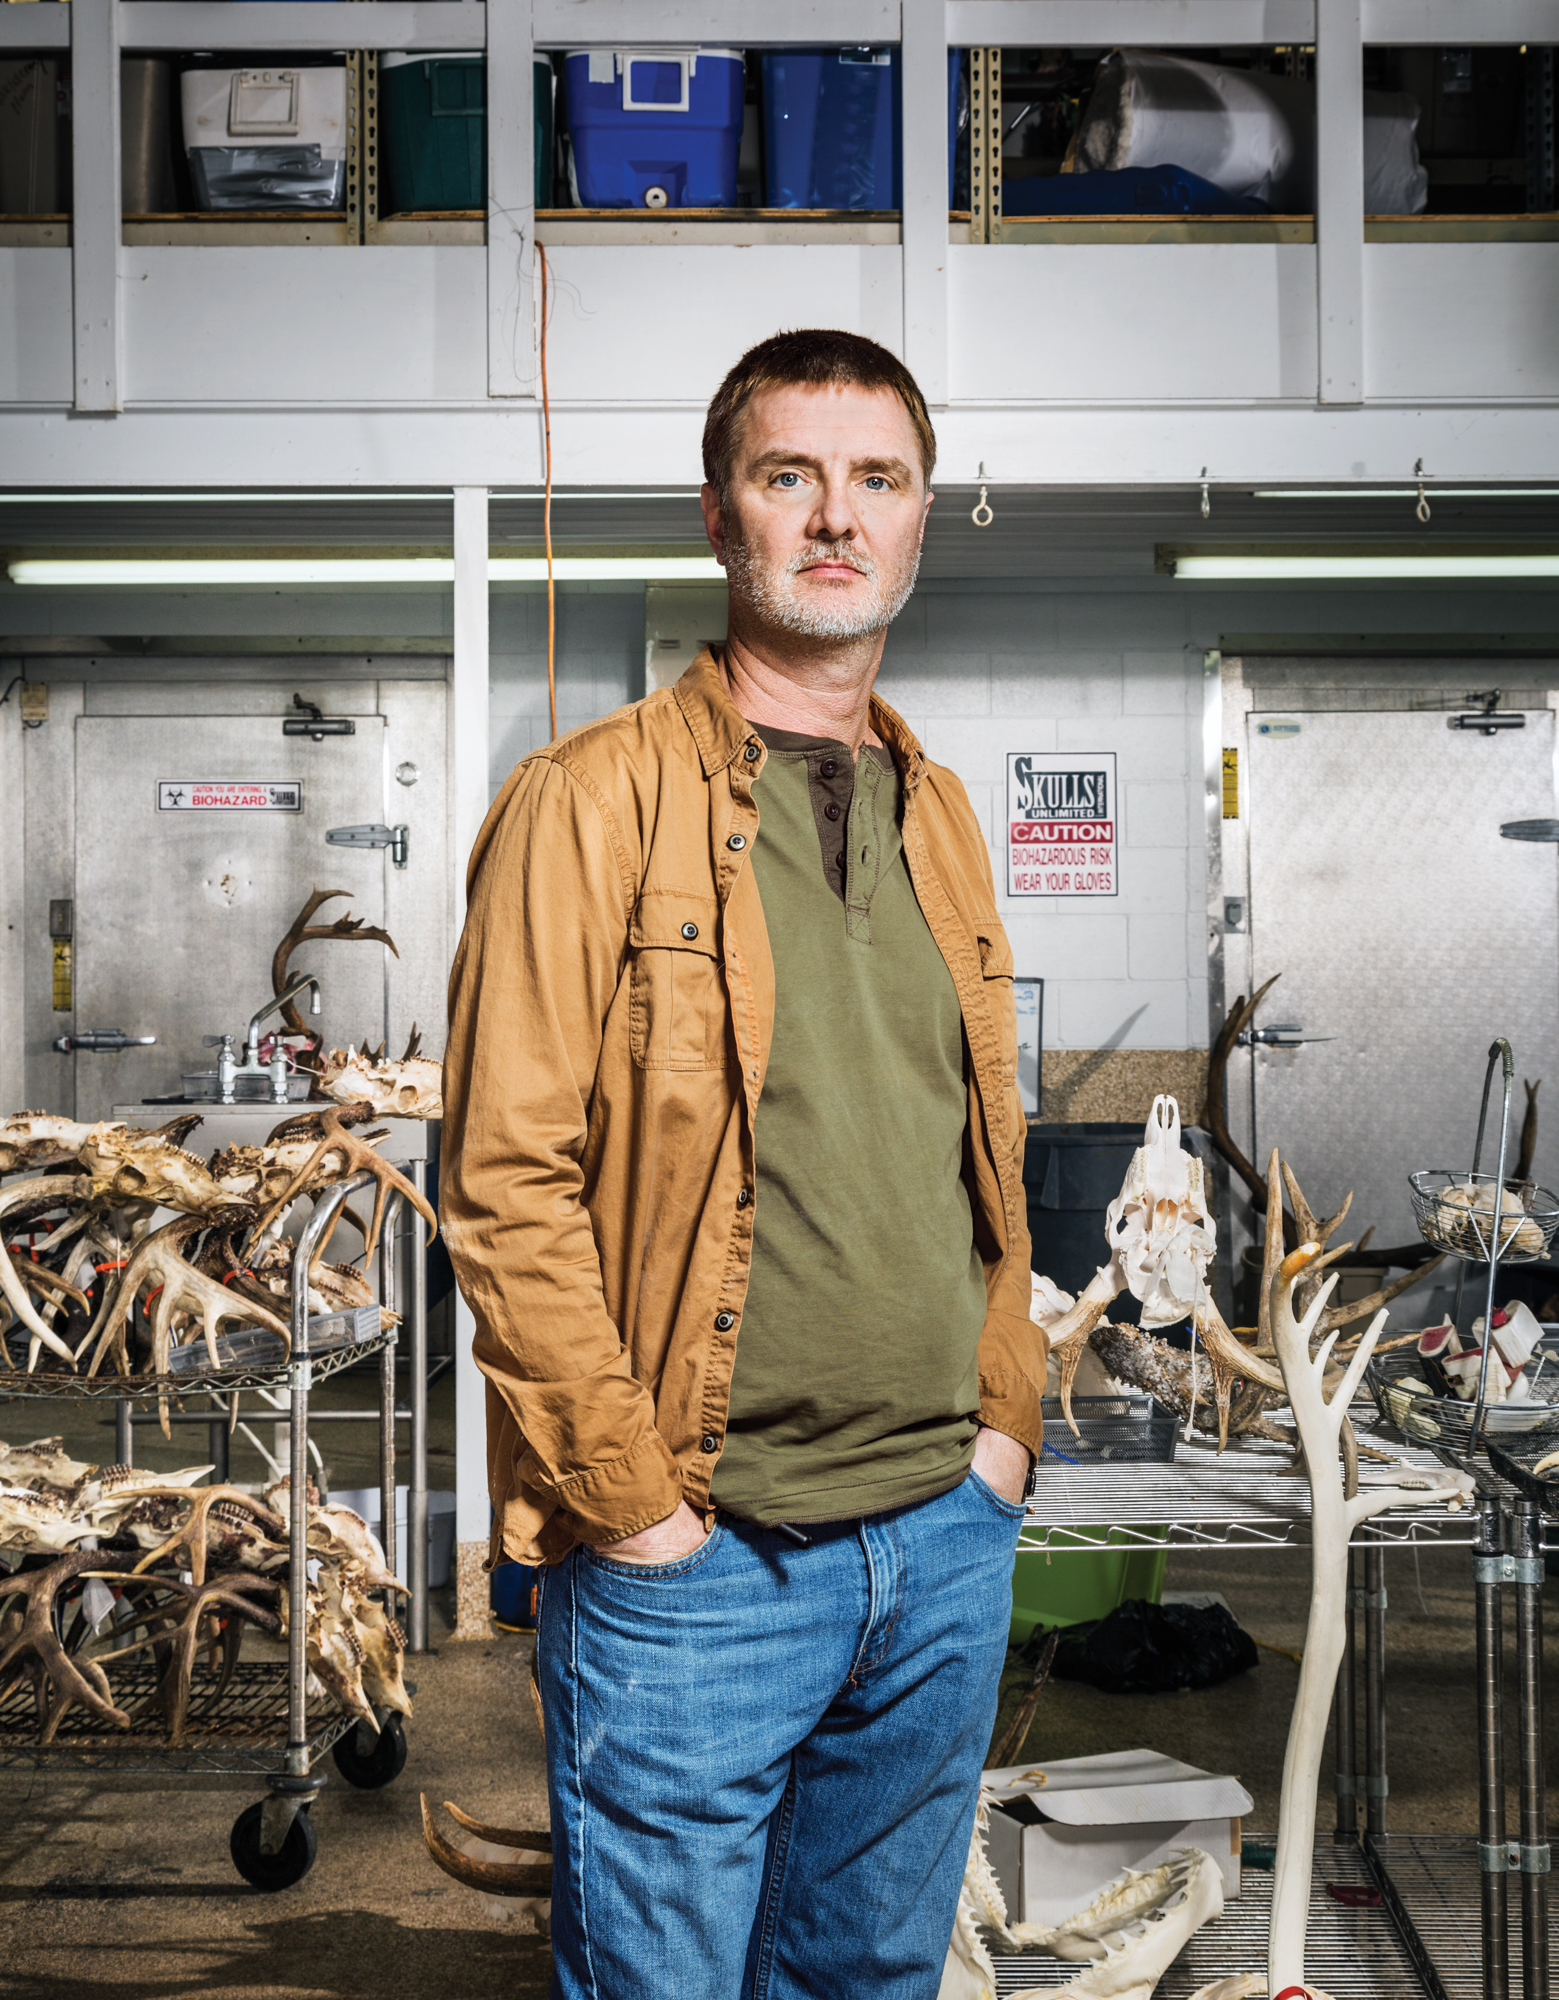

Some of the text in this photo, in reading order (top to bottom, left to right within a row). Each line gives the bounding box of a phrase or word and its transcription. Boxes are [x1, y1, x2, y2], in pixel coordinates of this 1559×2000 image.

[192, 785, 213, 793] CAUTION
[215, 785, 225, 793] YOU
[227, 785, 236, 793] ARE
[238, 785, 262, 793] ENTERING
[1014, 756, 1095, 811] SKULLS
[192, 795, 267, 806] BIOHAZARD
[1031, 809, 1095, 819] UNLIMITED
[1013, 824, 1112, 841] CAUTION
[1012, 847, 1112, 866] BIOHAZARDOUS RISK
[1013, 872, 1112, 891] WEAR YOUR GLOVES
